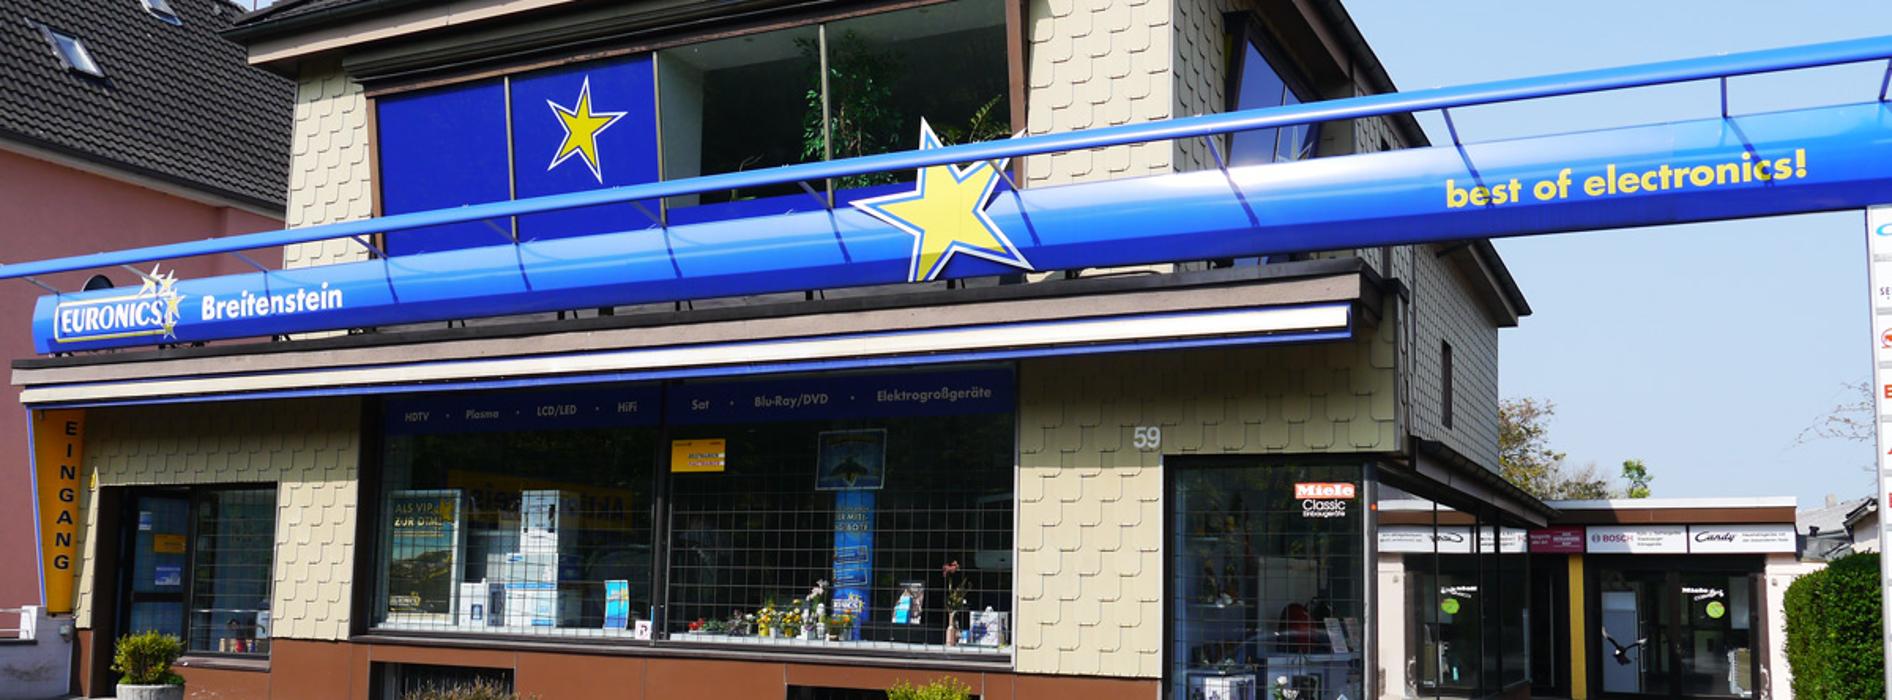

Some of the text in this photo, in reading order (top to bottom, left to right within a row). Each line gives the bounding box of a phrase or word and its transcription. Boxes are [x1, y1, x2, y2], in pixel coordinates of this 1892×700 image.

[1446, 148, 1809, 208] best of electronics!
[201, 282, 344, 321] Breitenstein
[61, 301, 164, 334] EURONICS
[691, 386, 992, 411] Sat Blu-Ray/DVD Elektrogroßgeräte
[404, 401, 638, 422] HDTV Plasma LCD/LED HiFi
[1133, 426, 1161, 448] 59
[53, 420, 78, 571] EINGANG
[1297, 484, 1355, 498] Miele
[1302, 499, 1346, 511] Classic
[1602, 533, 1634, 543] BOSCH
[1694, 531, 1736, 543] Candy
